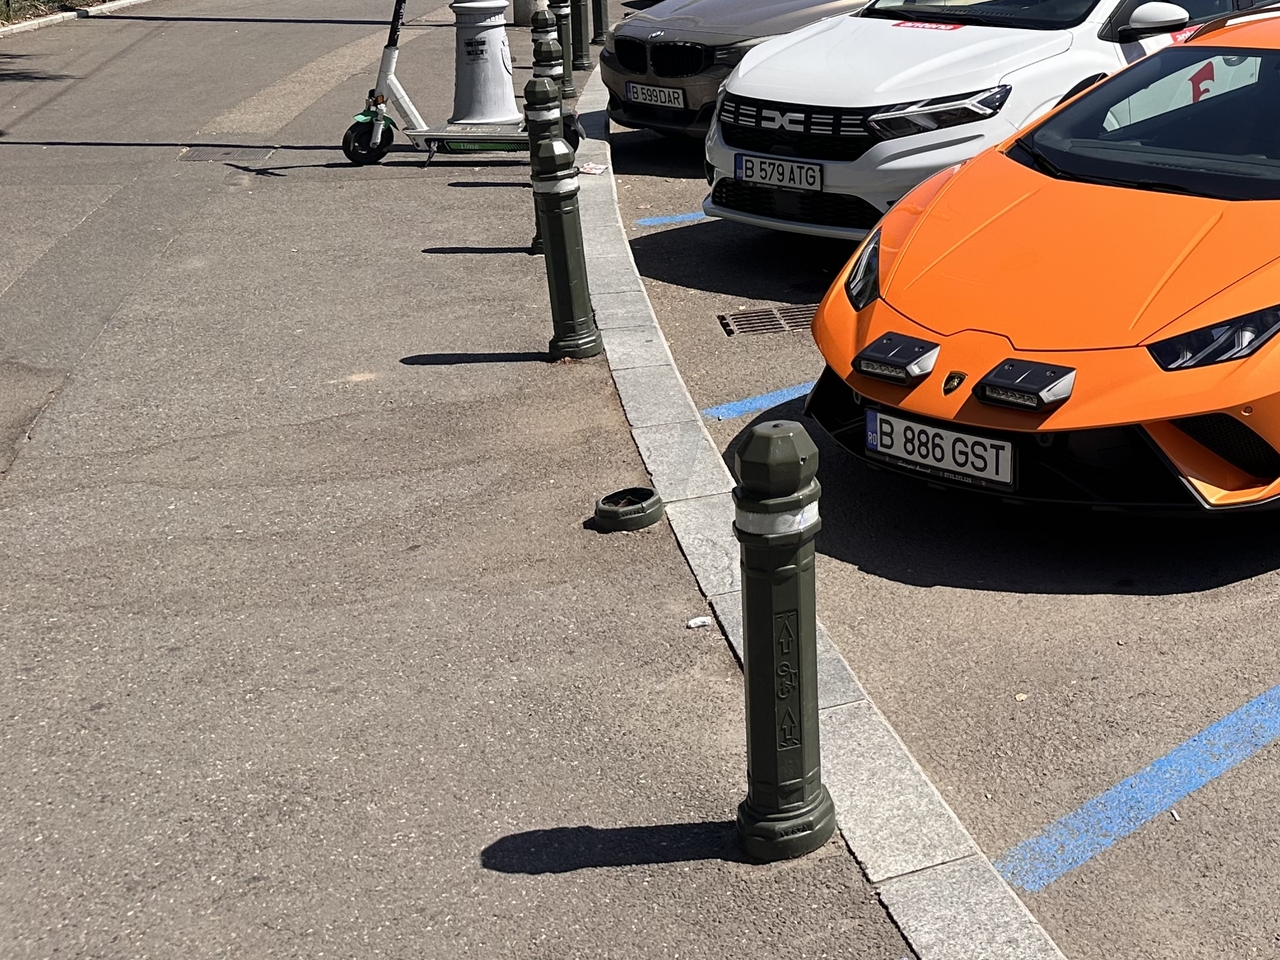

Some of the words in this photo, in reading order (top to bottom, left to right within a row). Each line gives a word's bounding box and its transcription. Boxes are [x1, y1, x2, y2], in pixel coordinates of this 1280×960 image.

[631, 86, 639, 100] B
[745, 159, 754, 178] B
[760, 161, 784, 182] 579
[788, 164, 816, 186] ATG
[867, 431, 877, 445] RO
[879, 418, 894, 450] B
[903, 425, 945, 463] 886
[952, 437, 1006, 476] GST
